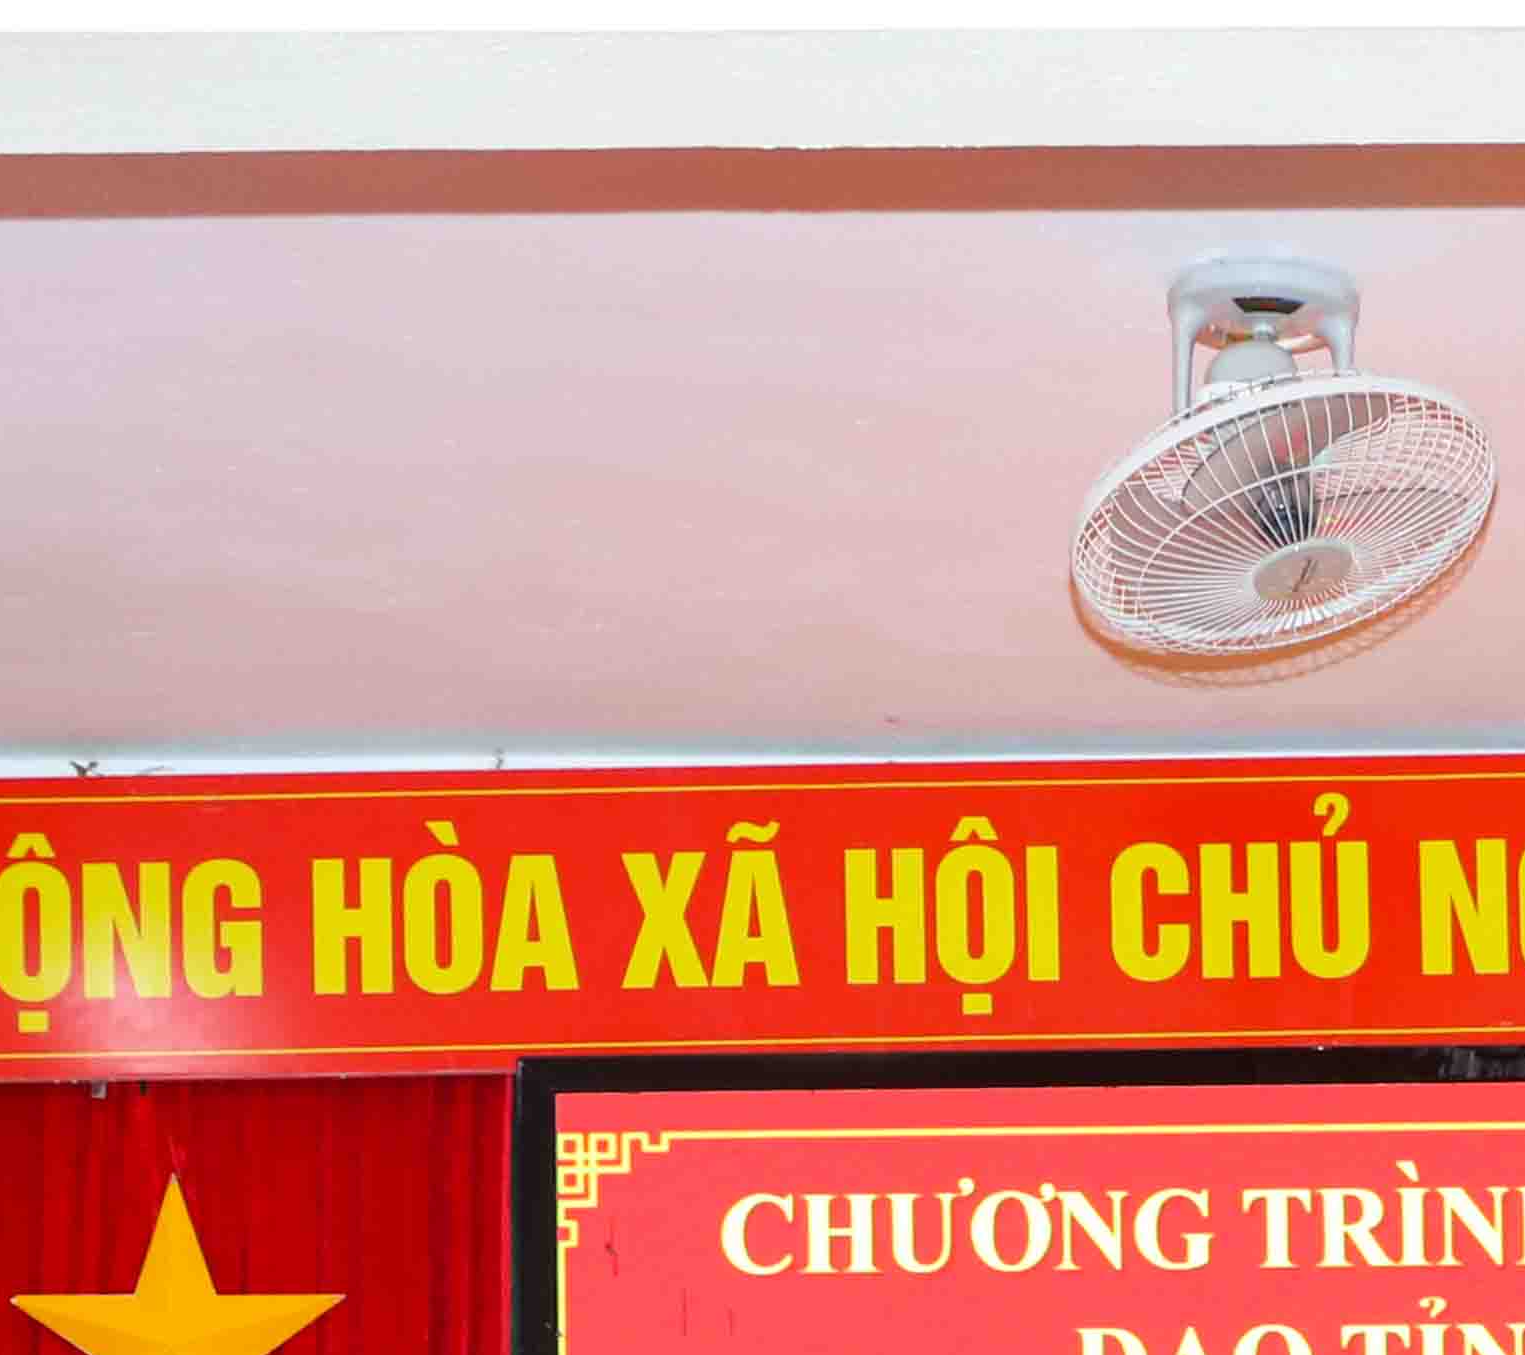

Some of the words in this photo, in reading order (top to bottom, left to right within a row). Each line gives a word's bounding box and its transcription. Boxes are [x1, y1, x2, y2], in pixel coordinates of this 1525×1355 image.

[313, 821, 579, 994] HÒA
[622, 822, 799, 988] XÃ
[845, 816, 1060, 1014] HỘI
[1111, 793, 1370, 981] CHỦ
[721, 1178, 1213, 1275] CHƯƠNG
